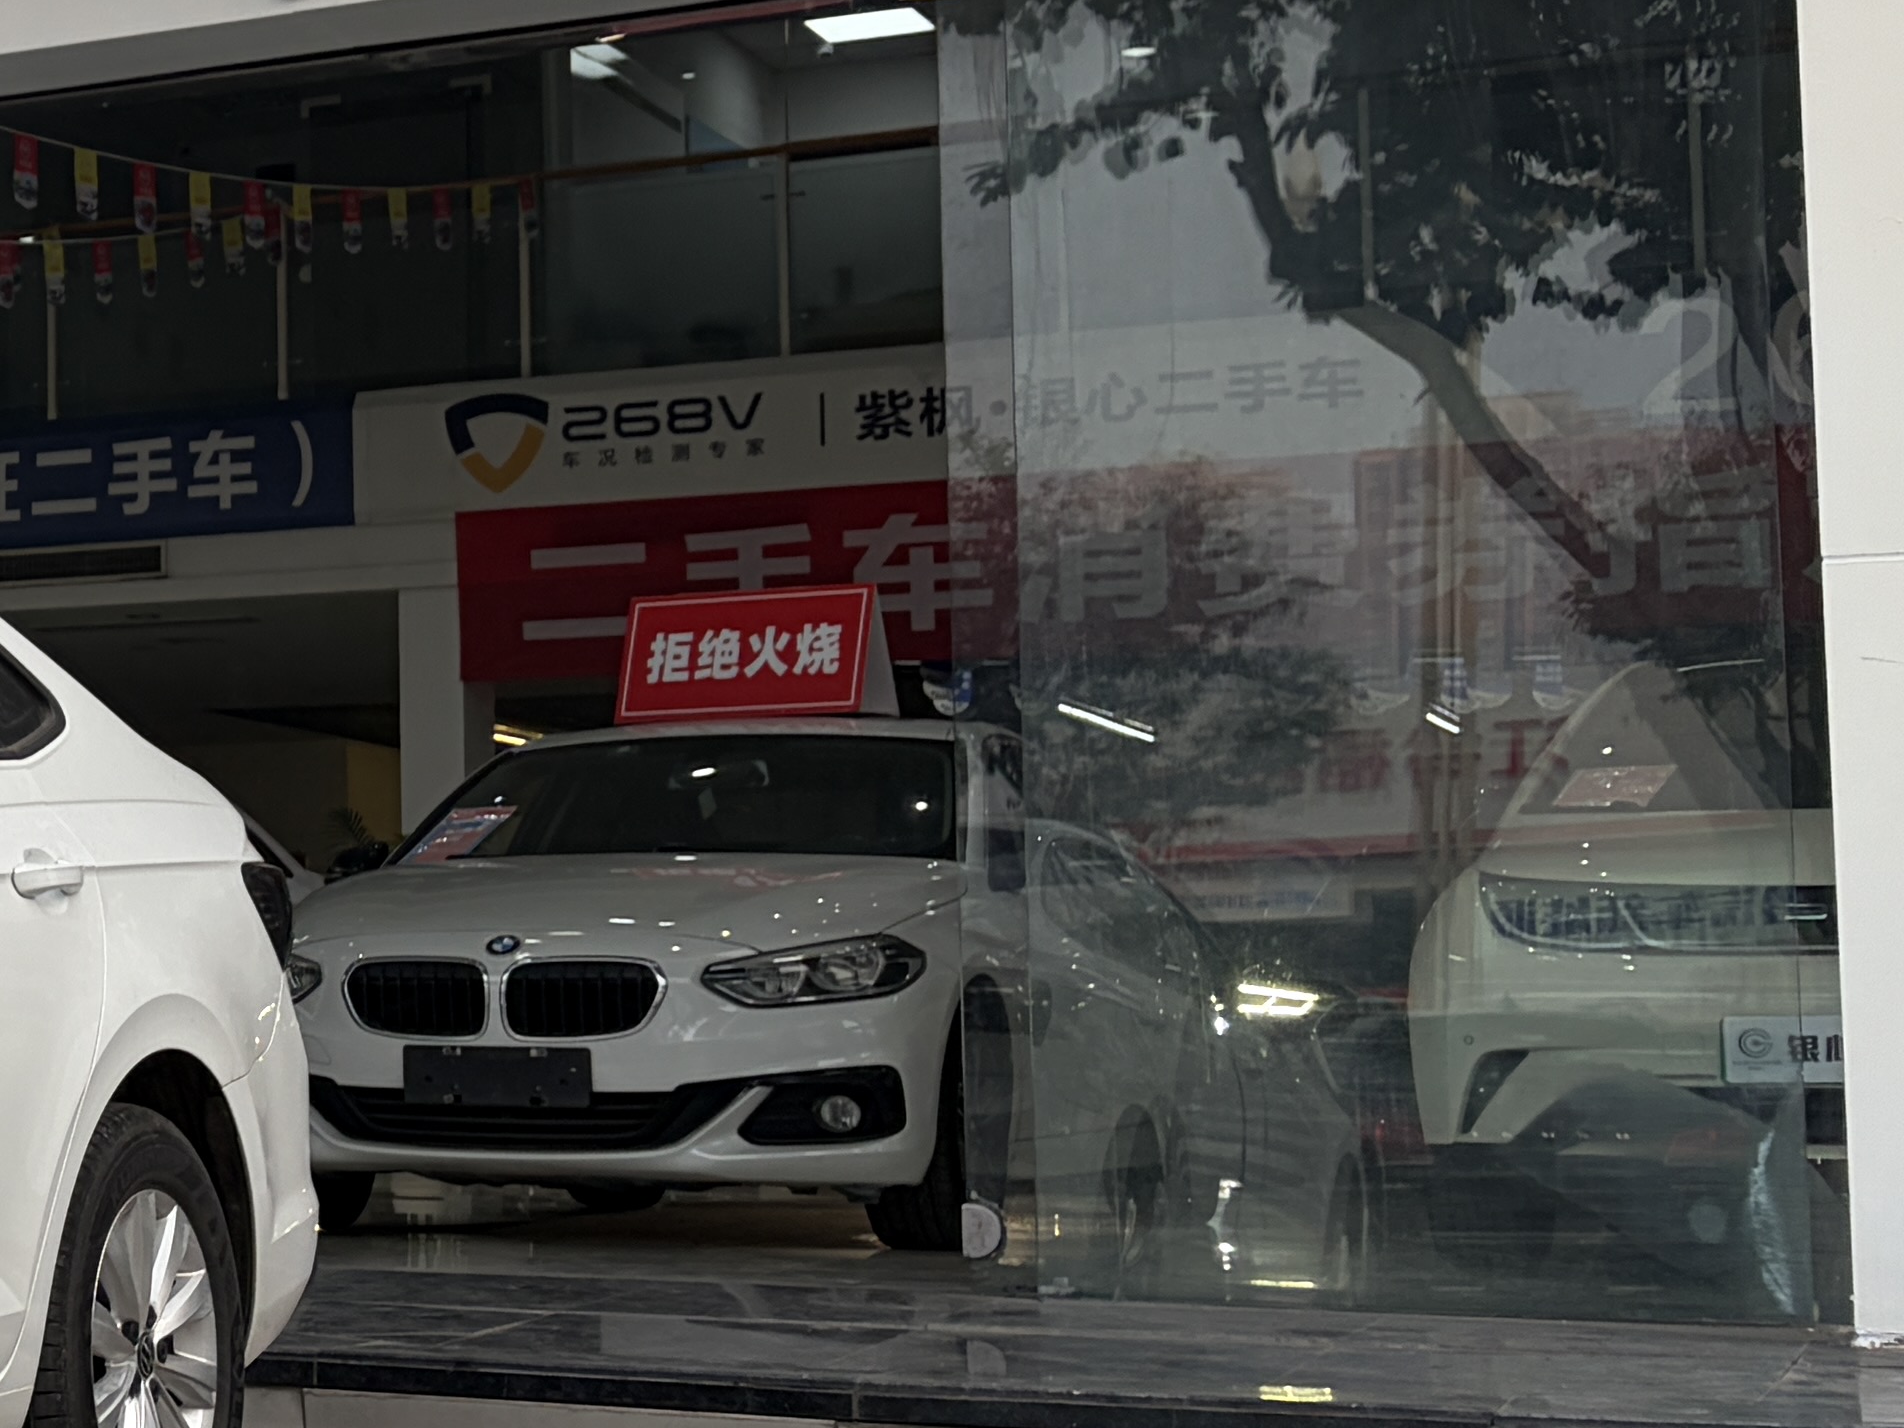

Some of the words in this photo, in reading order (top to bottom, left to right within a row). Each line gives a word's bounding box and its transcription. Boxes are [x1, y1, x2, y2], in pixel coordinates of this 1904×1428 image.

[561, 390, 764, 443] 268V
[562, 437, 766, 468] 车况检测专家
[645, 621, 843, 685] 拒绝火烧
